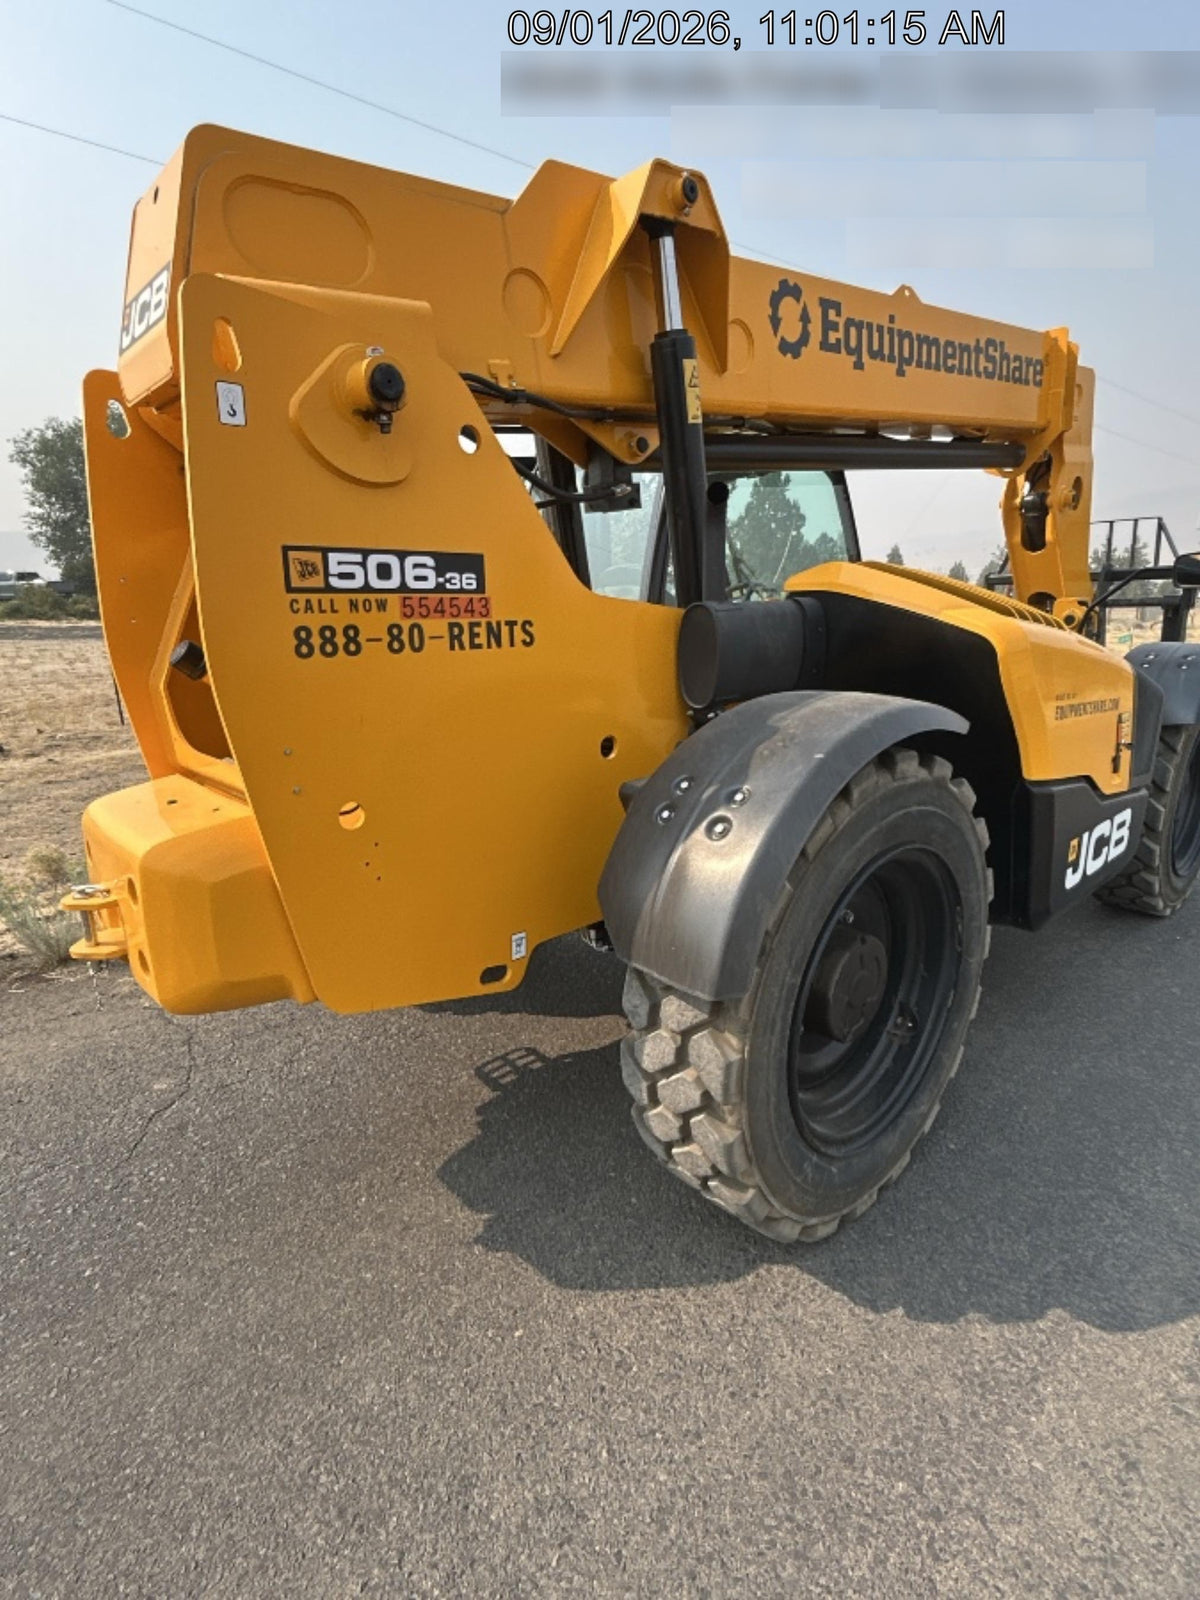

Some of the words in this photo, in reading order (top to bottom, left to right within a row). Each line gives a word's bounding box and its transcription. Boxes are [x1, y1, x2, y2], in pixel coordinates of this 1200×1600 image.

[121, 268, 168, 350] JCB
[818, 297, 1043, 387] EquipmentShare
[327, 552, 478, 590] 506-36
[289, 598, 339, 614] CALL
[349, 598, 389, 613] NOW
[402, 597, 490, 619] 554543
[293, 620, 536, 659] 888-80-RENTS
[1064, 807, 1132, 890] JCB
